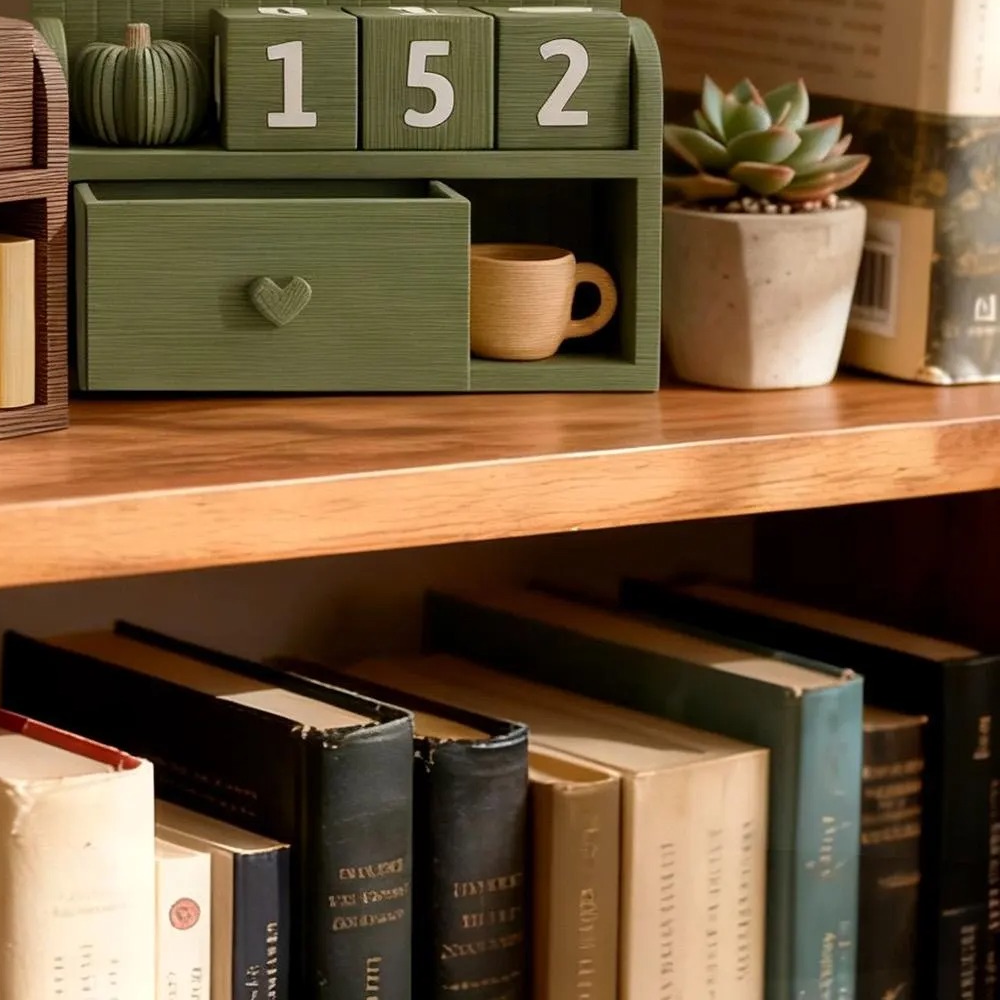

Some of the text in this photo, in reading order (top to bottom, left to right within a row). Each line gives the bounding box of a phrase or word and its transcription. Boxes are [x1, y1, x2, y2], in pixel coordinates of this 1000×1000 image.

[266, 38, 590, 128] 1 5 2
